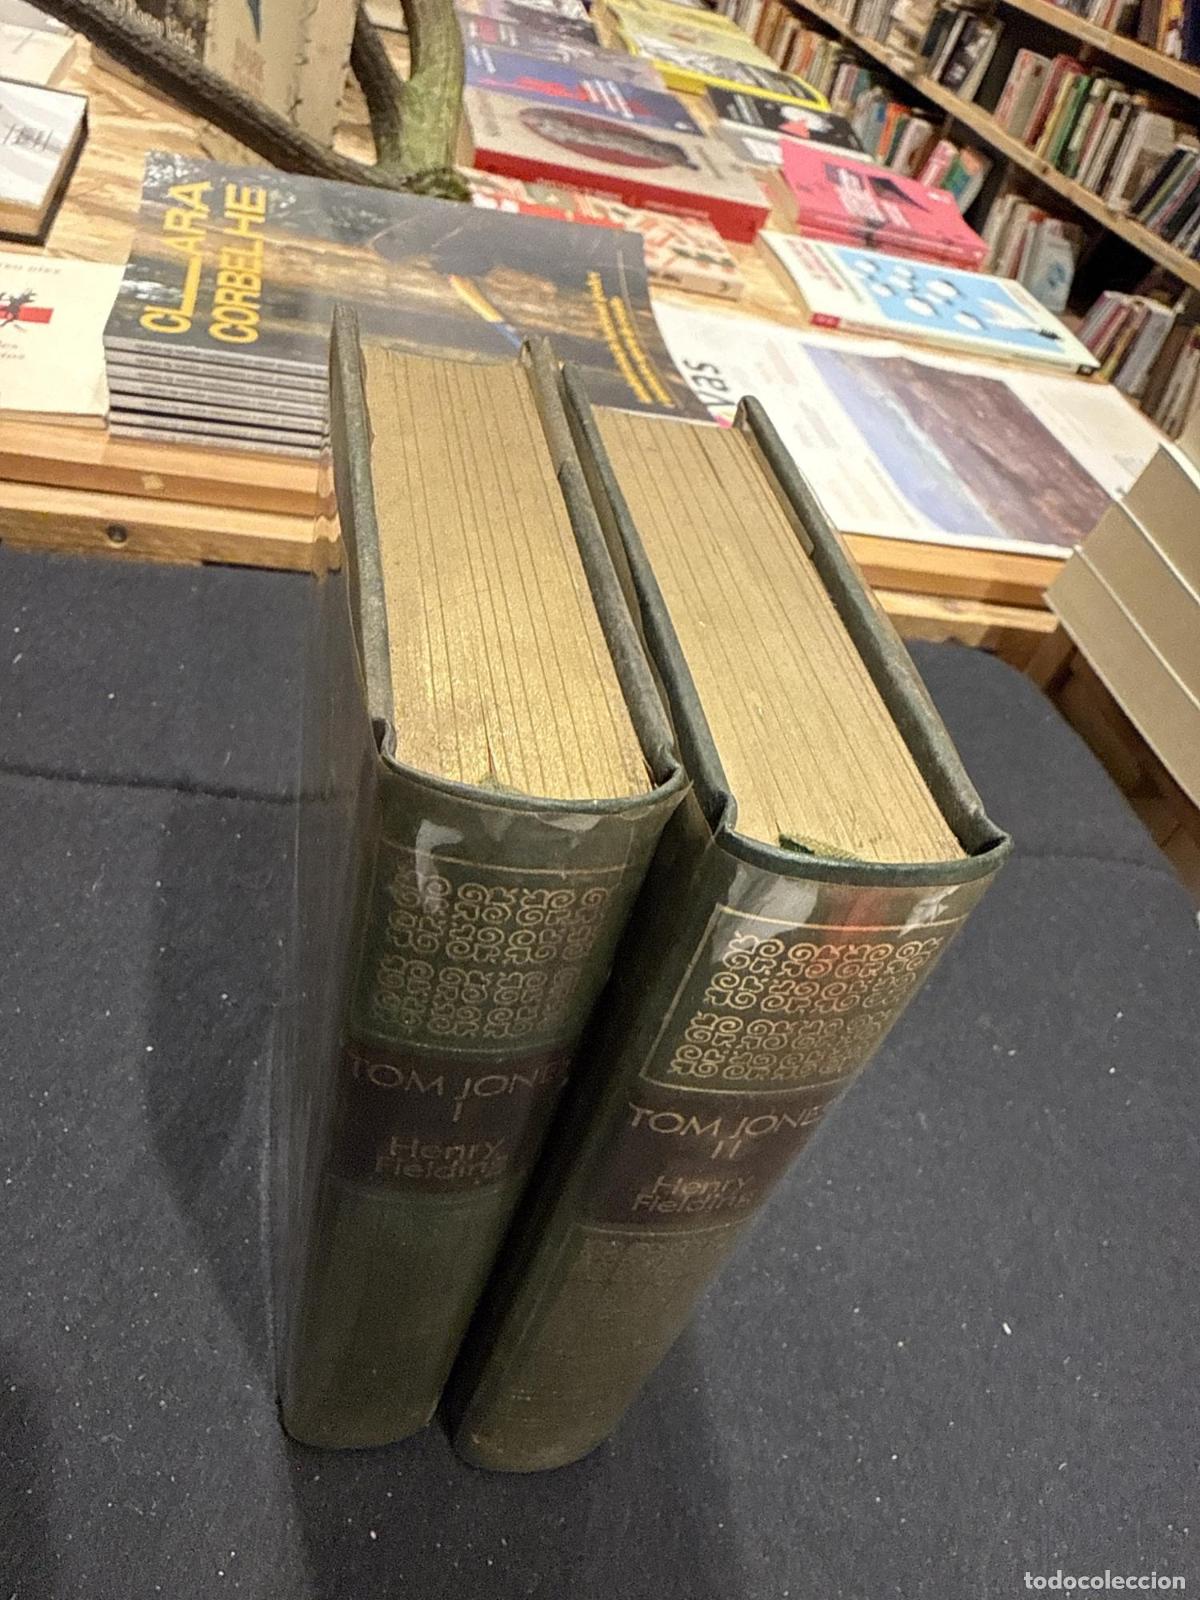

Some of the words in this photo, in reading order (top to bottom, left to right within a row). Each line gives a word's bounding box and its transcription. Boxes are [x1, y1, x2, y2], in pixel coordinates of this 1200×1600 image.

[139, 181, 213, 334] CLARA
[348, 1054, 444, 1097] TOM
[628, 1101, 723, 1137] TOM
[728, 1104, 827, 1140] JONE
[389, 1135, 506, 1165] Henry
[709, 1139, 743, 1160] II
[651, 1175, 755, 1196] Henry
